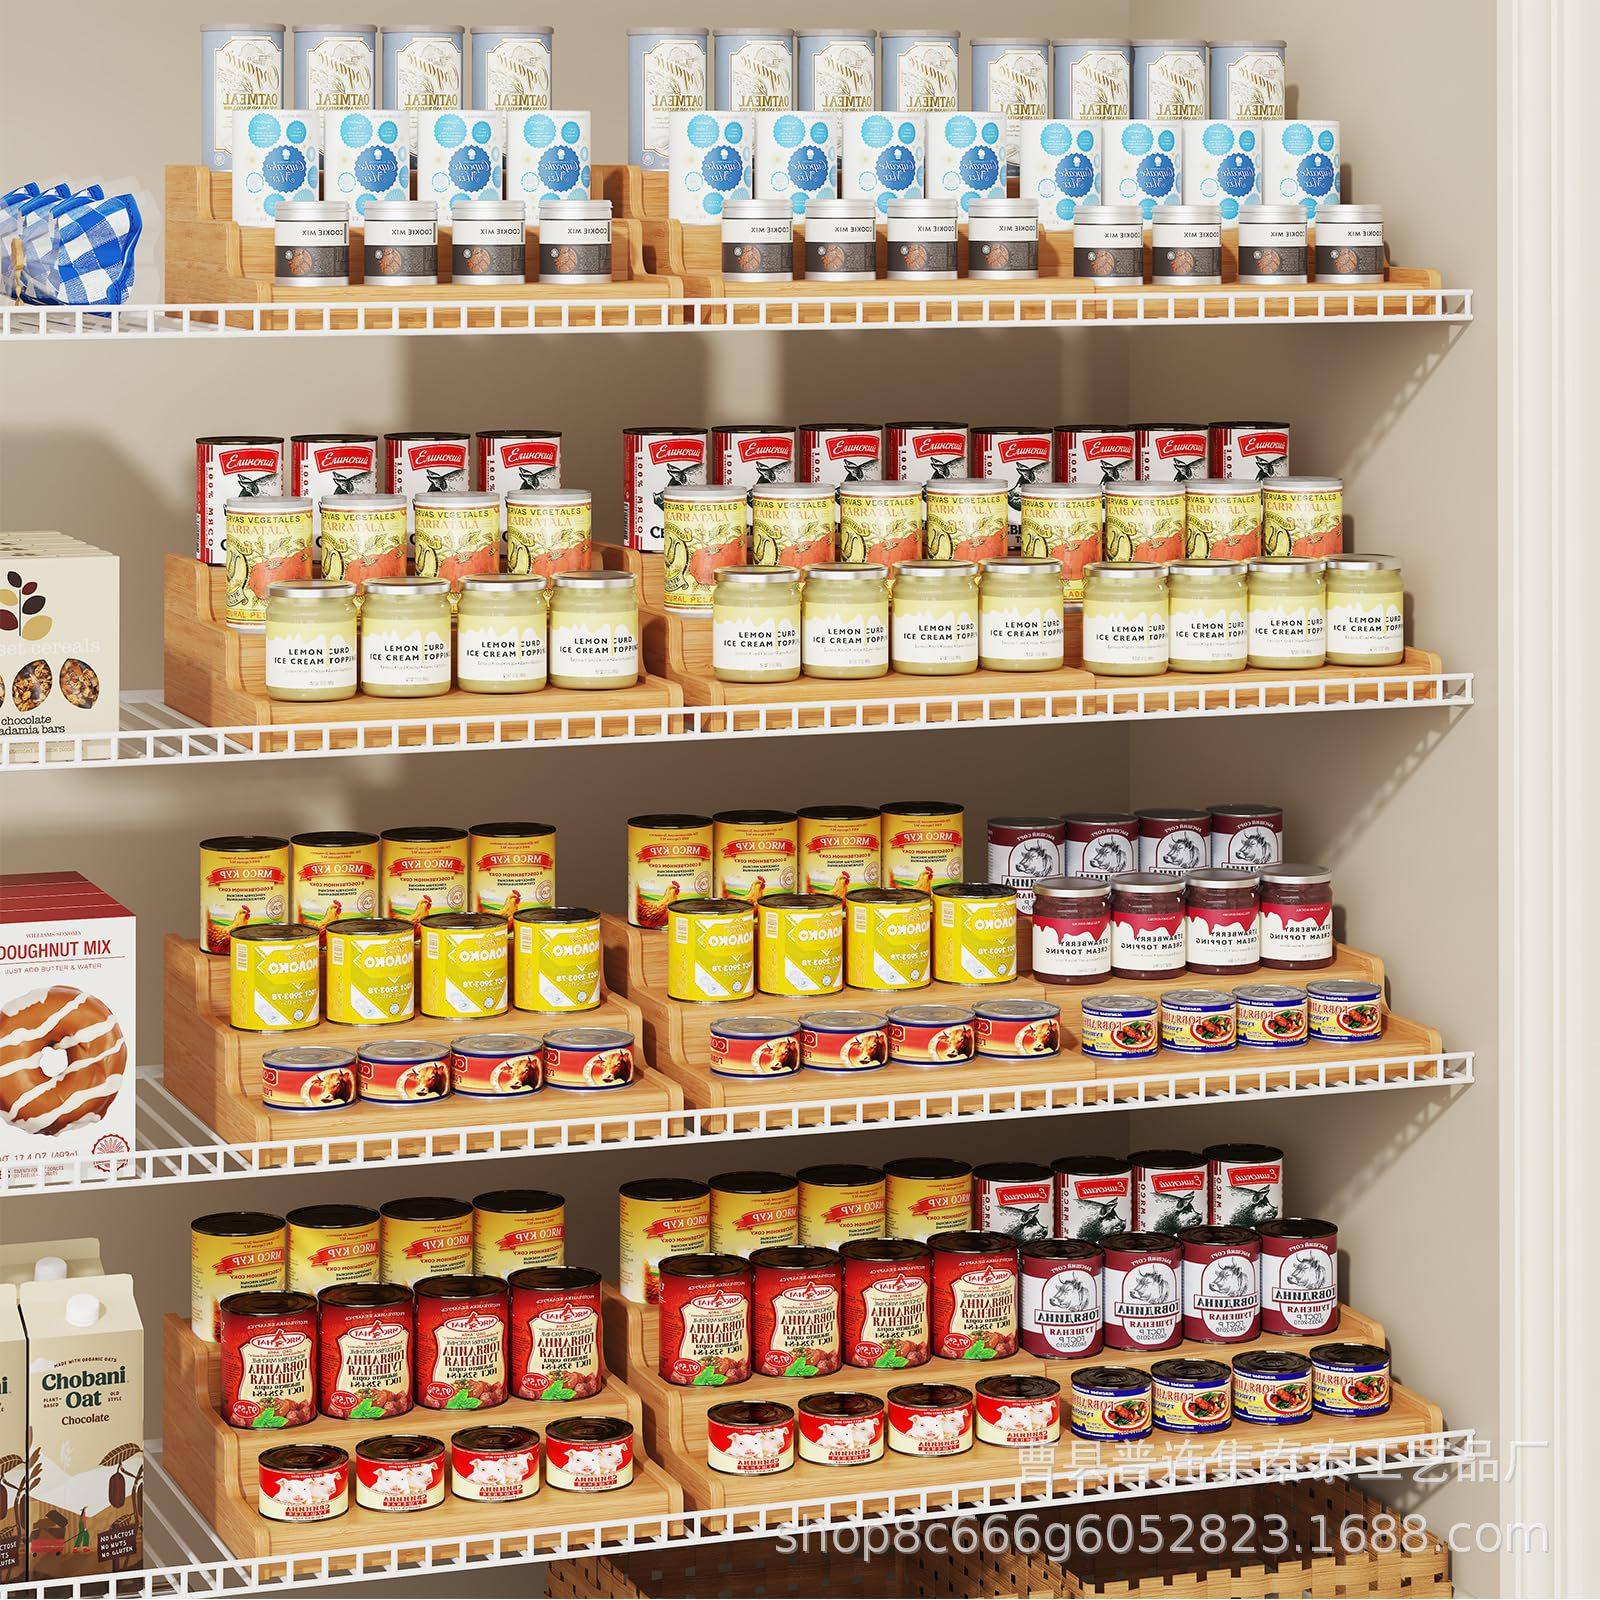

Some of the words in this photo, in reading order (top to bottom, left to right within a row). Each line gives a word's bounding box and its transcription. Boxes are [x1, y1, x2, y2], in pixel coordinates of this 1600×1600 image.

[745, 443, 790, 457] Елинский
[833, 441, 878, 454] Елинский
[920, 439, 964, 452] Елинский
[415, 451, 463, 464] Елинский
[508, 449, 555, 462] Елинский
[656, 445, 702, 459] Елинский
[226, 455, 275, 469] Елинский
[321, 453, 369, 467] Елинский
[532, 508, 581, 516] VEGETALES
[689, 503, 738, 511] VEGETALES
[249, 516, 300, 524] VEGETALES
[345, 513, 395, 521] VEGETALES
[1112, 626, 1144, 634] LEMON
[614, 636, 632, 644] CURD
[329, 647, 350, 655] CURD
[1, 715, 52, 726] chocolate
[42, 725, 66, 734] bars
[0, 941, 79, 961] DOUGHNUT
[84, 939, 111, 955] MIX
[41, 964, 69, 973] BUTTER
[77, 962, 102, 970] WATER
[53, 1360, 67, 1368] MADE
[42, 1366, 126, 1391] Chobani
[65, 1390, 102, 1409] Oat
[61, 1413, 110, 1426] Chocolate
[100, 1534, 108, 1542] NO
[109, 1528, 135, 1541] LACTOSE
[100, 1543, 110, 1551] NO
[111, 1540, 127, 1549] NUTS
[101, 1550, 111, 1558] NO
[111, 1546, 134, 1557] GLUTEN
